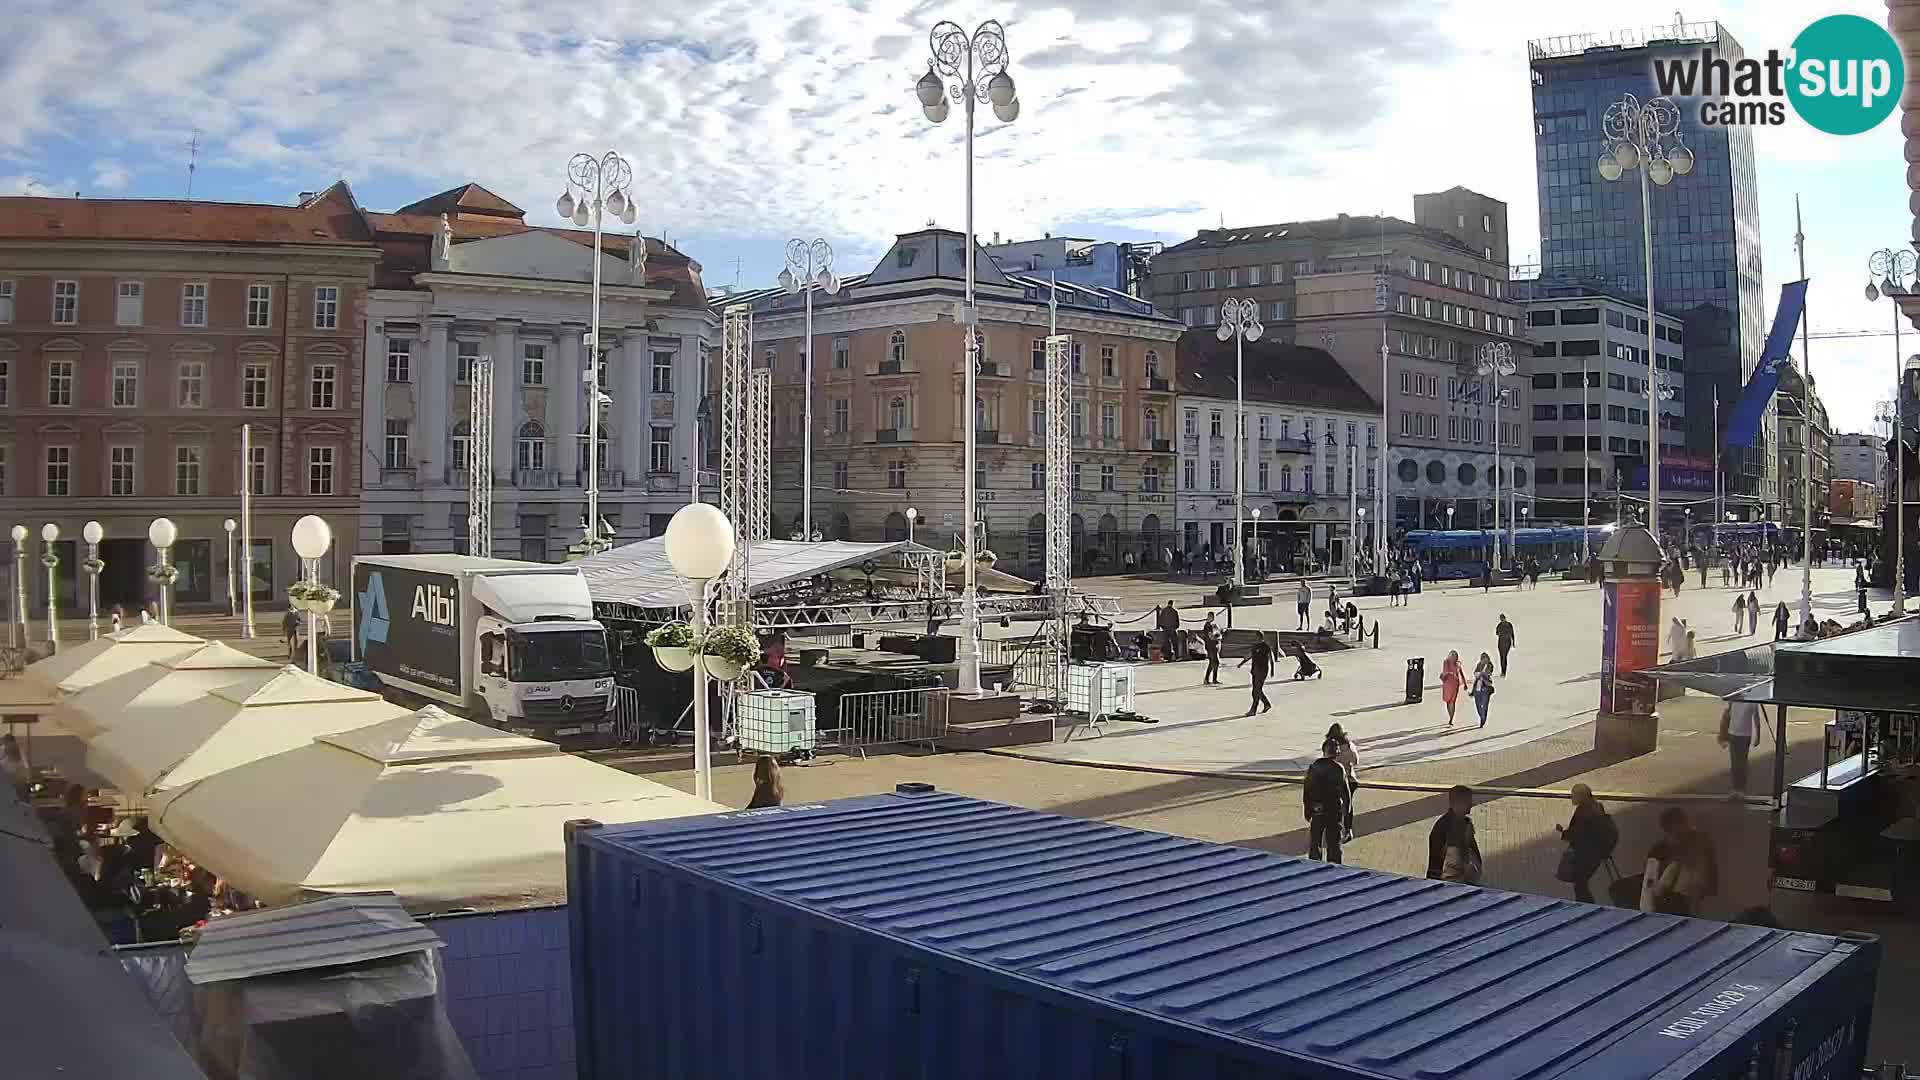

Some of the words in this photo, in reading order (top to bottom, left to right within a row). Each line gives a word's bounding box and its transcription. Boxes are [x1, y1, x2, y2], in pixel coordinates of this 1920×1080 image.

[411, 584, 455, 626] Alibi
[1658, 1015, 1708, 1039] MCDU
[1692, 990, 1745, 1018] 300629
[1734, 983, 1760, 992] 6
